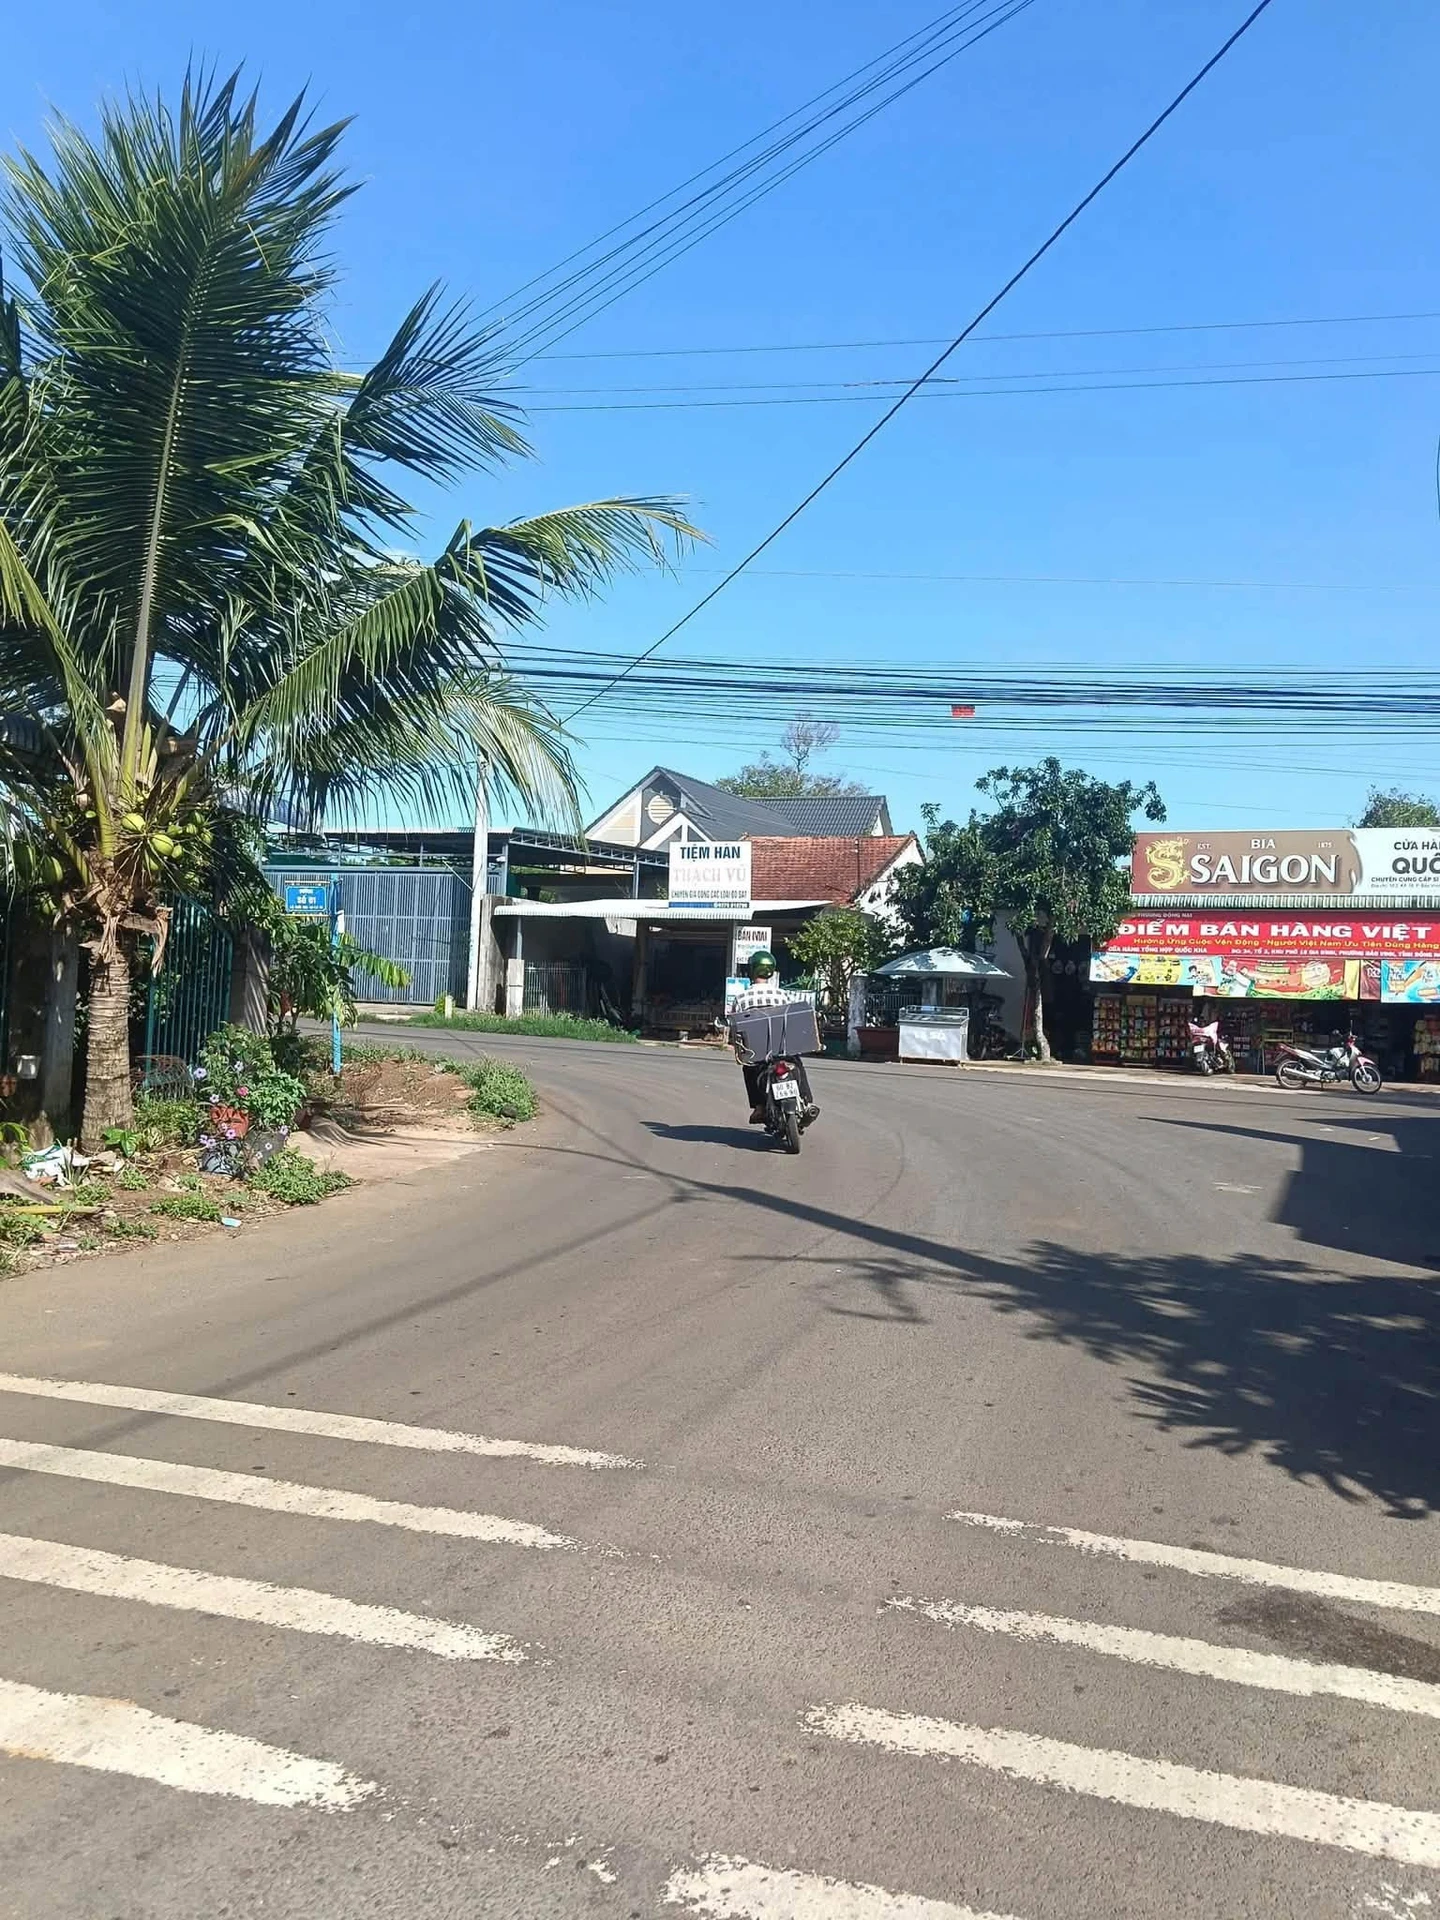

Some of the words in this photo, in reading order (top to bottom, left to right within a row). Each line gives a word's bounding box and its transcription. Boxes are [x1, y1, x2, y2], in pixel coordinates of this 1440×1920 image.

[680, 843, 710, 862] TIỆM
[1250, 838, 1276, 849] BIA
[1393, 838, 1418, 850] CỬA
[1421, 838, 1440, 850] HÀ
[1191, 853, 1338, 884] SAIGON
[1117, 919, 1189, 936] ĐIỂM
[1200, 921, 1259, 936] BÁN
[1270, 921, 1352, 938] HÀNG
[1361, 923, 1432, 941] VIỆT
